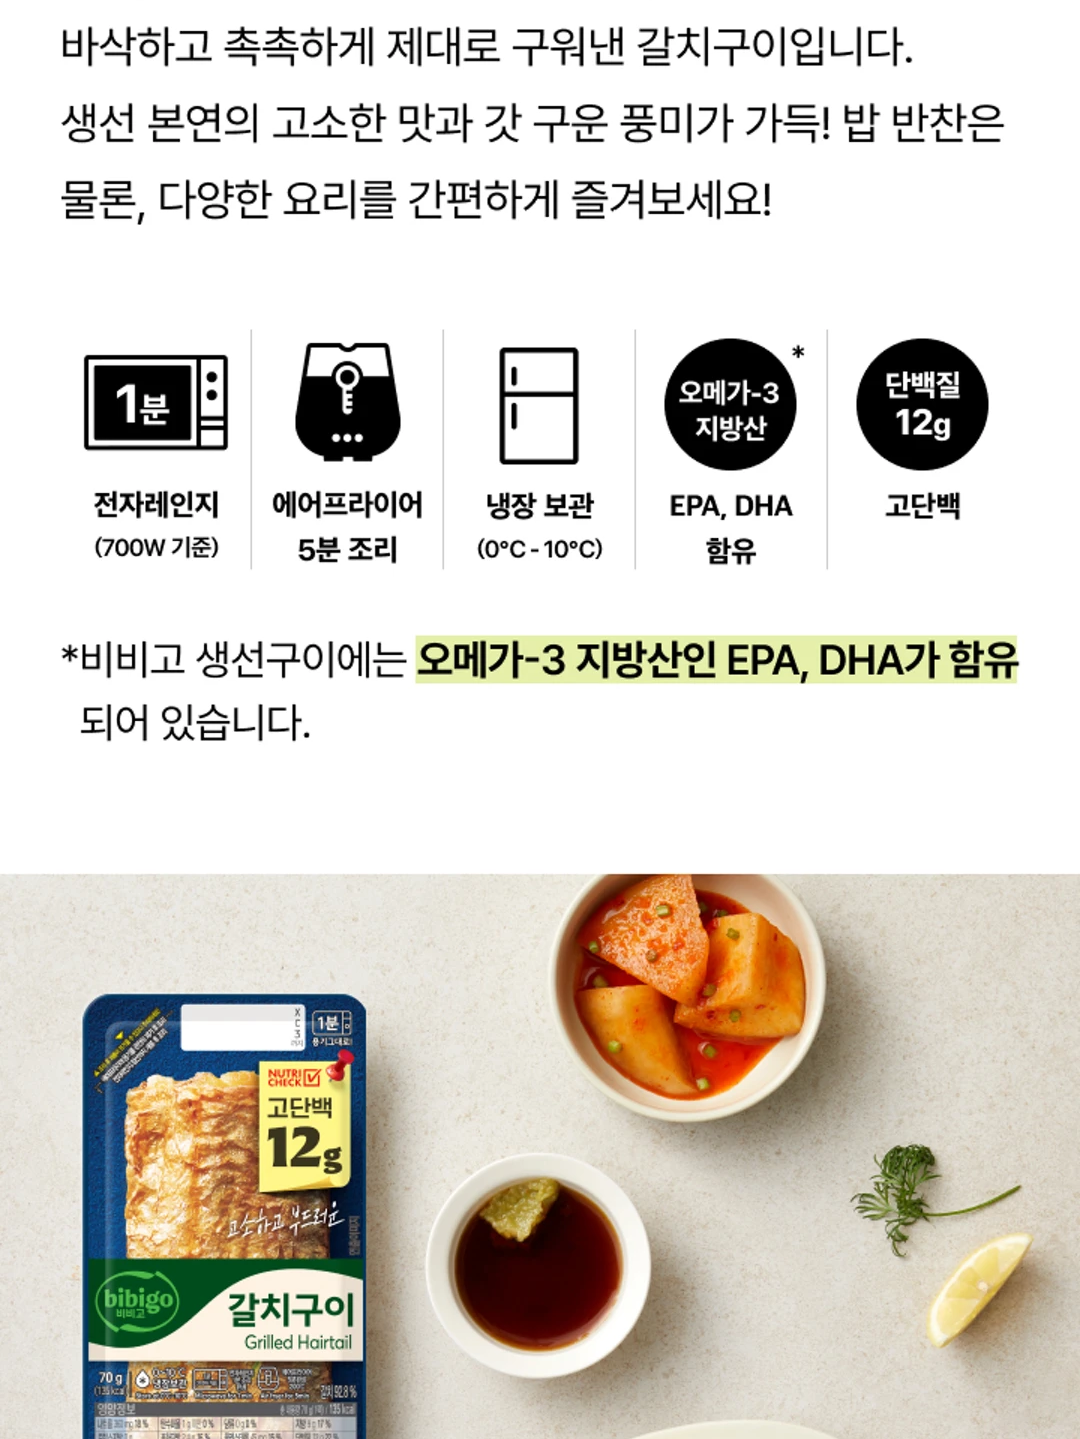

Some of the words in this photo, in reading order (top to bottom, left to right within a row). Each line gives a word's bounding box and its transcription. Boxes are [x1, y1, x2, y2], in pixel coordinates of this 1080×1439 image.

[62, 26, 213, 67] 바삭하고
[224, 26, 374, 67] 촉촉하게
[387, 26, 501, 67] 제대로
[512, 26, 625, 67] 구워낸
[637, 26, 913, 67] 갈치구이입니다.
[61, 102, 134, 143] 생선
[147, 102, 258, 144] 본연의
[272, 102, 387, 143] 고소한
[399, 102, 474, 144] 맛과
[485, 102, 523, 143] 갓
[533, 103, 609, 144] 구운
[620, 102, 735, 144] 풍미가
[745, 102, 830, 144] 가득!
[844, 102, 881, 143] 밥
[893, 102, 1005, 143] 반찬은
[60, 180, 145, 226] 물론,
[160, 179, 273, 220] 다양한
[283, 179, 397, 220] 요리를
[409, 179, 558, 220] 간편하게
[571, 179, 771, 220] 즐겨보세요!
[678, 379, 780, 406] 오메가-3
[886, 370, 961, 399] 단백질
[116, 384, 170, 426] 1분
[695, 415, 768, 442] 지방산
[896, 408, 951, 442] 12g
[94, 490, 219, 519] 전자레인지
[272, 490, 422, 519] 에어프라이어
[486, 492, 538, 521] 냉장
[543, 492, 595, 520] 보관
[670, 494, 727, 521] EPA,
[735, 494, 794, 517] DHA
[885, 492, 960, 521] 고단백
[95, 536, 166, 559] (700W
[171, 535, 219, 559] 기준)
[298, 536, 341, 563] 5분
[347, 535, 397, 564] 조리
[705, 537, 757, 565] 함유
[196, 640, 407, 679] 생선구이에는
[417, 640, 566, 679] 오메가-3
[576, 640, 716, 679] 지방산인
[728, 644, 809, 684] EPA,
[820, 640, 941, 679] DHA가
[948, 640, 1020, 679] 함유
[80, 703, 148, 742] 되어
[161, 703, 310, 742] 있습니다.
[317, 1015, 340, 1031] 1분
[268, 1068, 302, 1079] NUTRI
[268, 1078, 302, 1087] CHECK
[267, 1097, 333, 1119] 고단백
[267, 1126, 343, 1174] 12g
[227, 1208, 284, 1237] 고소하고
[289, 1201, 345, 1236] 부드러운
[104, 1287, 174, 1314] bibigo
[116, 1308, 146, 1319] 비비고
[228, 1292, 354, 1328] 갈치구이
[244, 1334, 294, 1350] Grilled
[297, 1334, 352, 1350] Hairtail
[98, 1371, 114, 1384] 70
[115, 1374, 123, 1386] g
